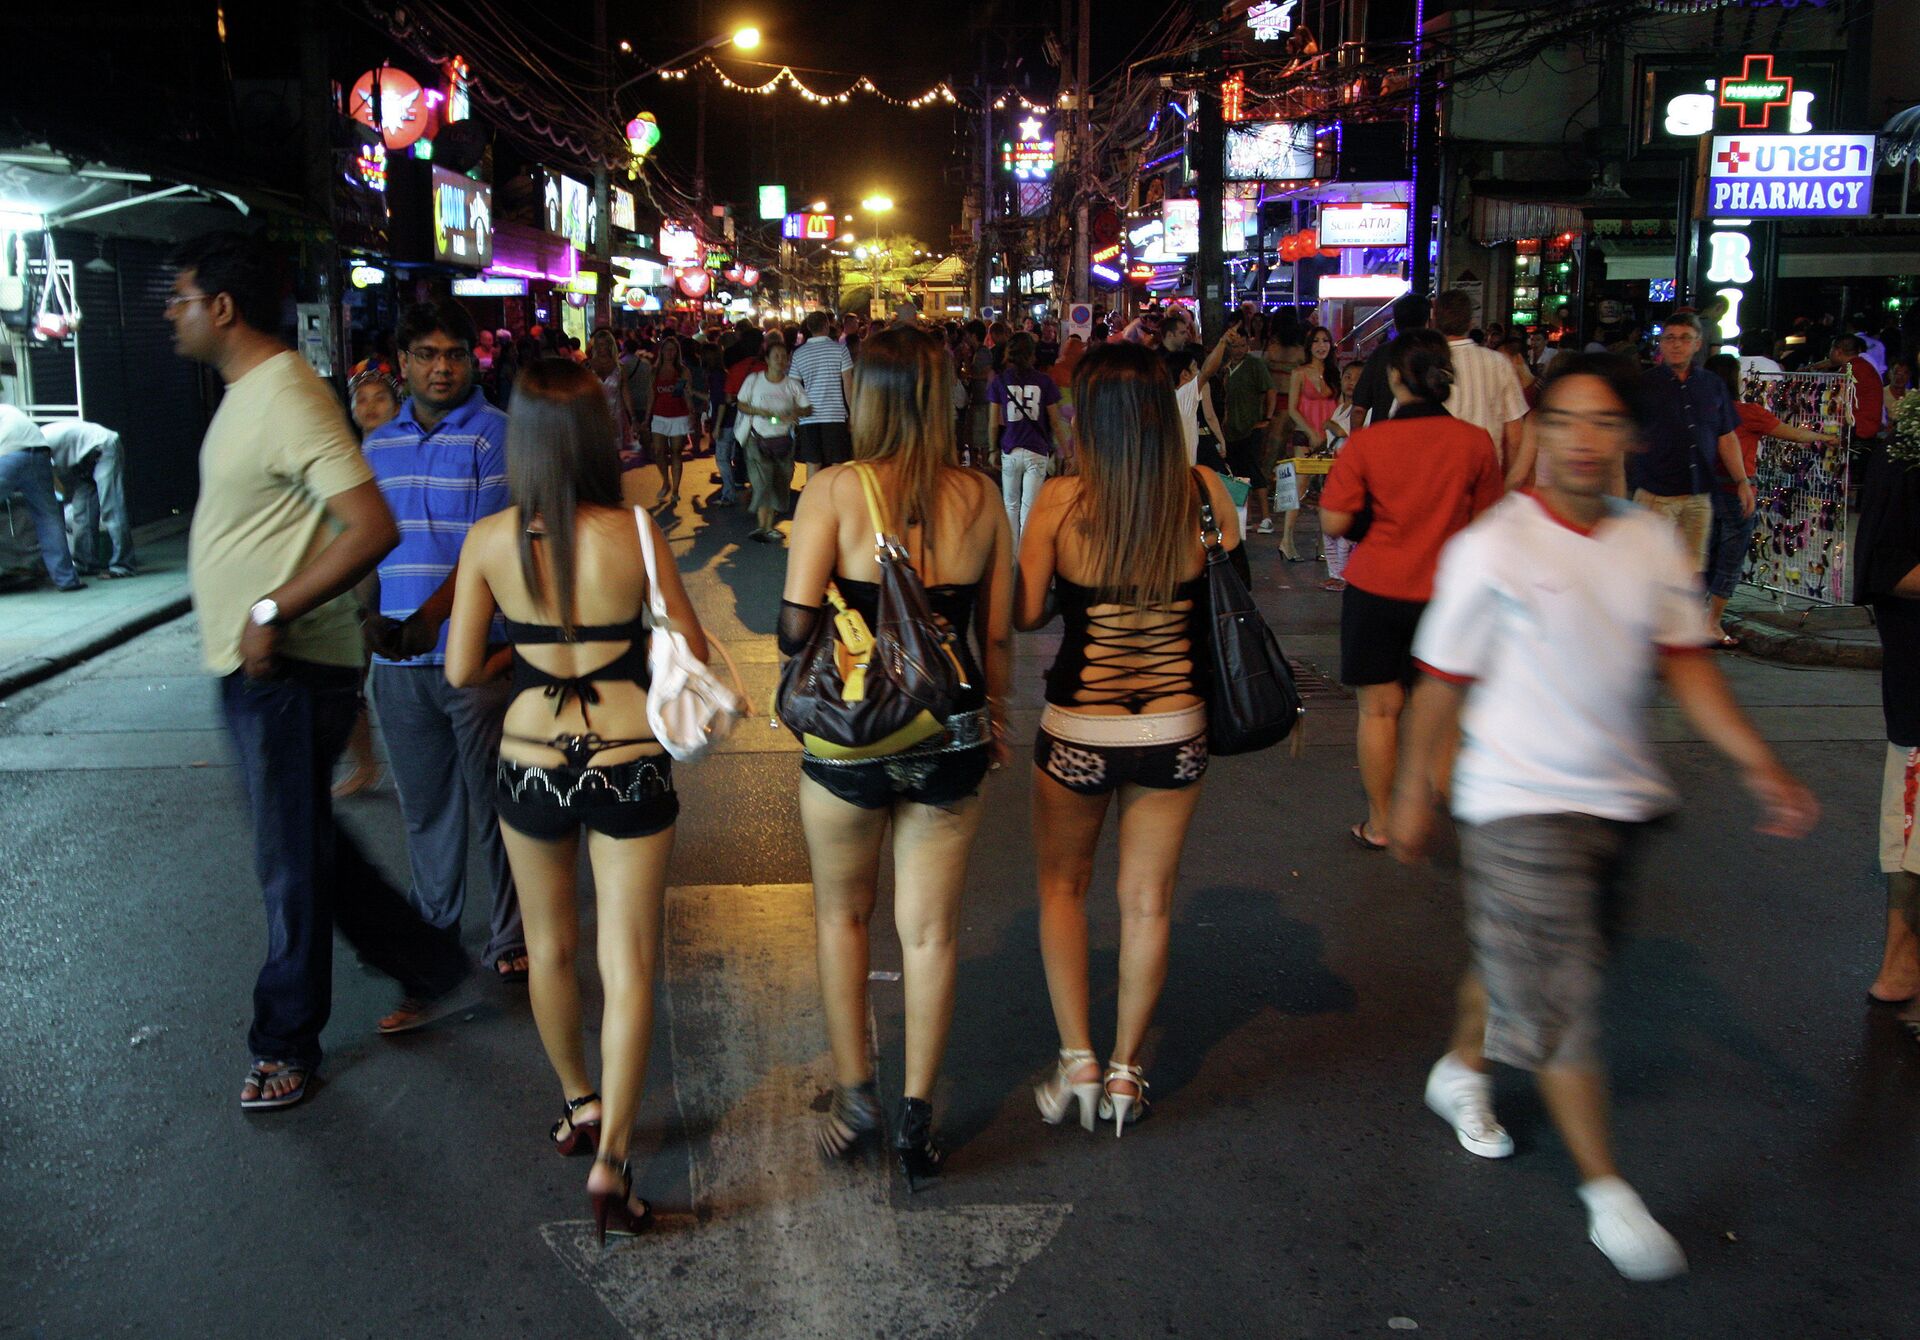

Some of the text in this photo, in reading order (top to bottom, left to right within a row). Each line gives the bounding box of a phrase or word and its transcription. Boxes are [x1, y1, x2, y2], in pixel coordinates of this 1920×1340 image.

[1725, 85, 1784, 98] PHARMACY
[1755, 144, 1868, 172] ขายยา
[1714, 182, 1864, 210] PHARMACY
[1358, 217, 1391, 229] ATM
[1007, 385, 1041, 422] 23
